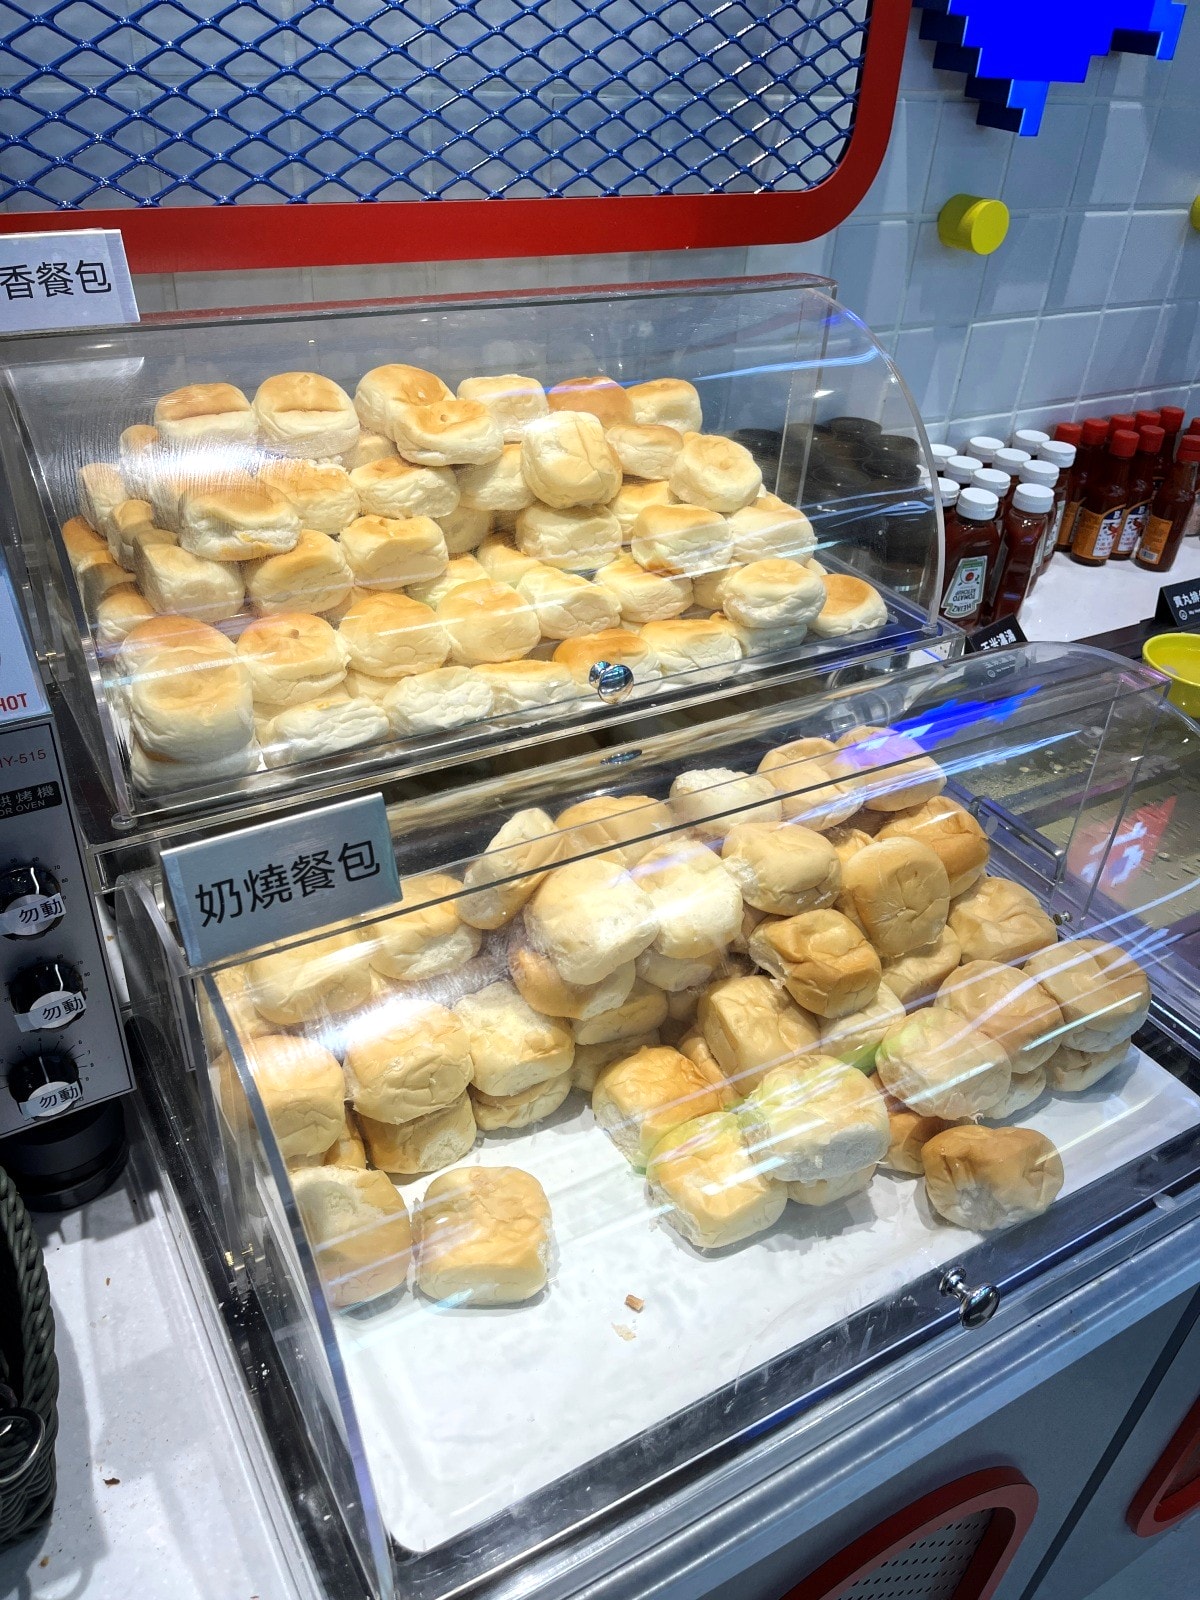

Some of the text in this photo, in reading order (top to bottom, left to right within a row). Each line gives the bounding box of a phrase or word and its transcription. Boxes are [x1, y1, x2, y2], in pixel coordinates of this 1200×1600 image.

[0, 260, 111, 300] 香餐包
[952, 603, 972, 612] HEINZ
[16, 800, 45, 812] OVEN
[195, 840, 381, 928] 奶燒餐包
[19, 898, 63, 923] 勿動
[42, 997, 84, 1020] 勿動
[39, 1085, 79, 1109] 勿動
